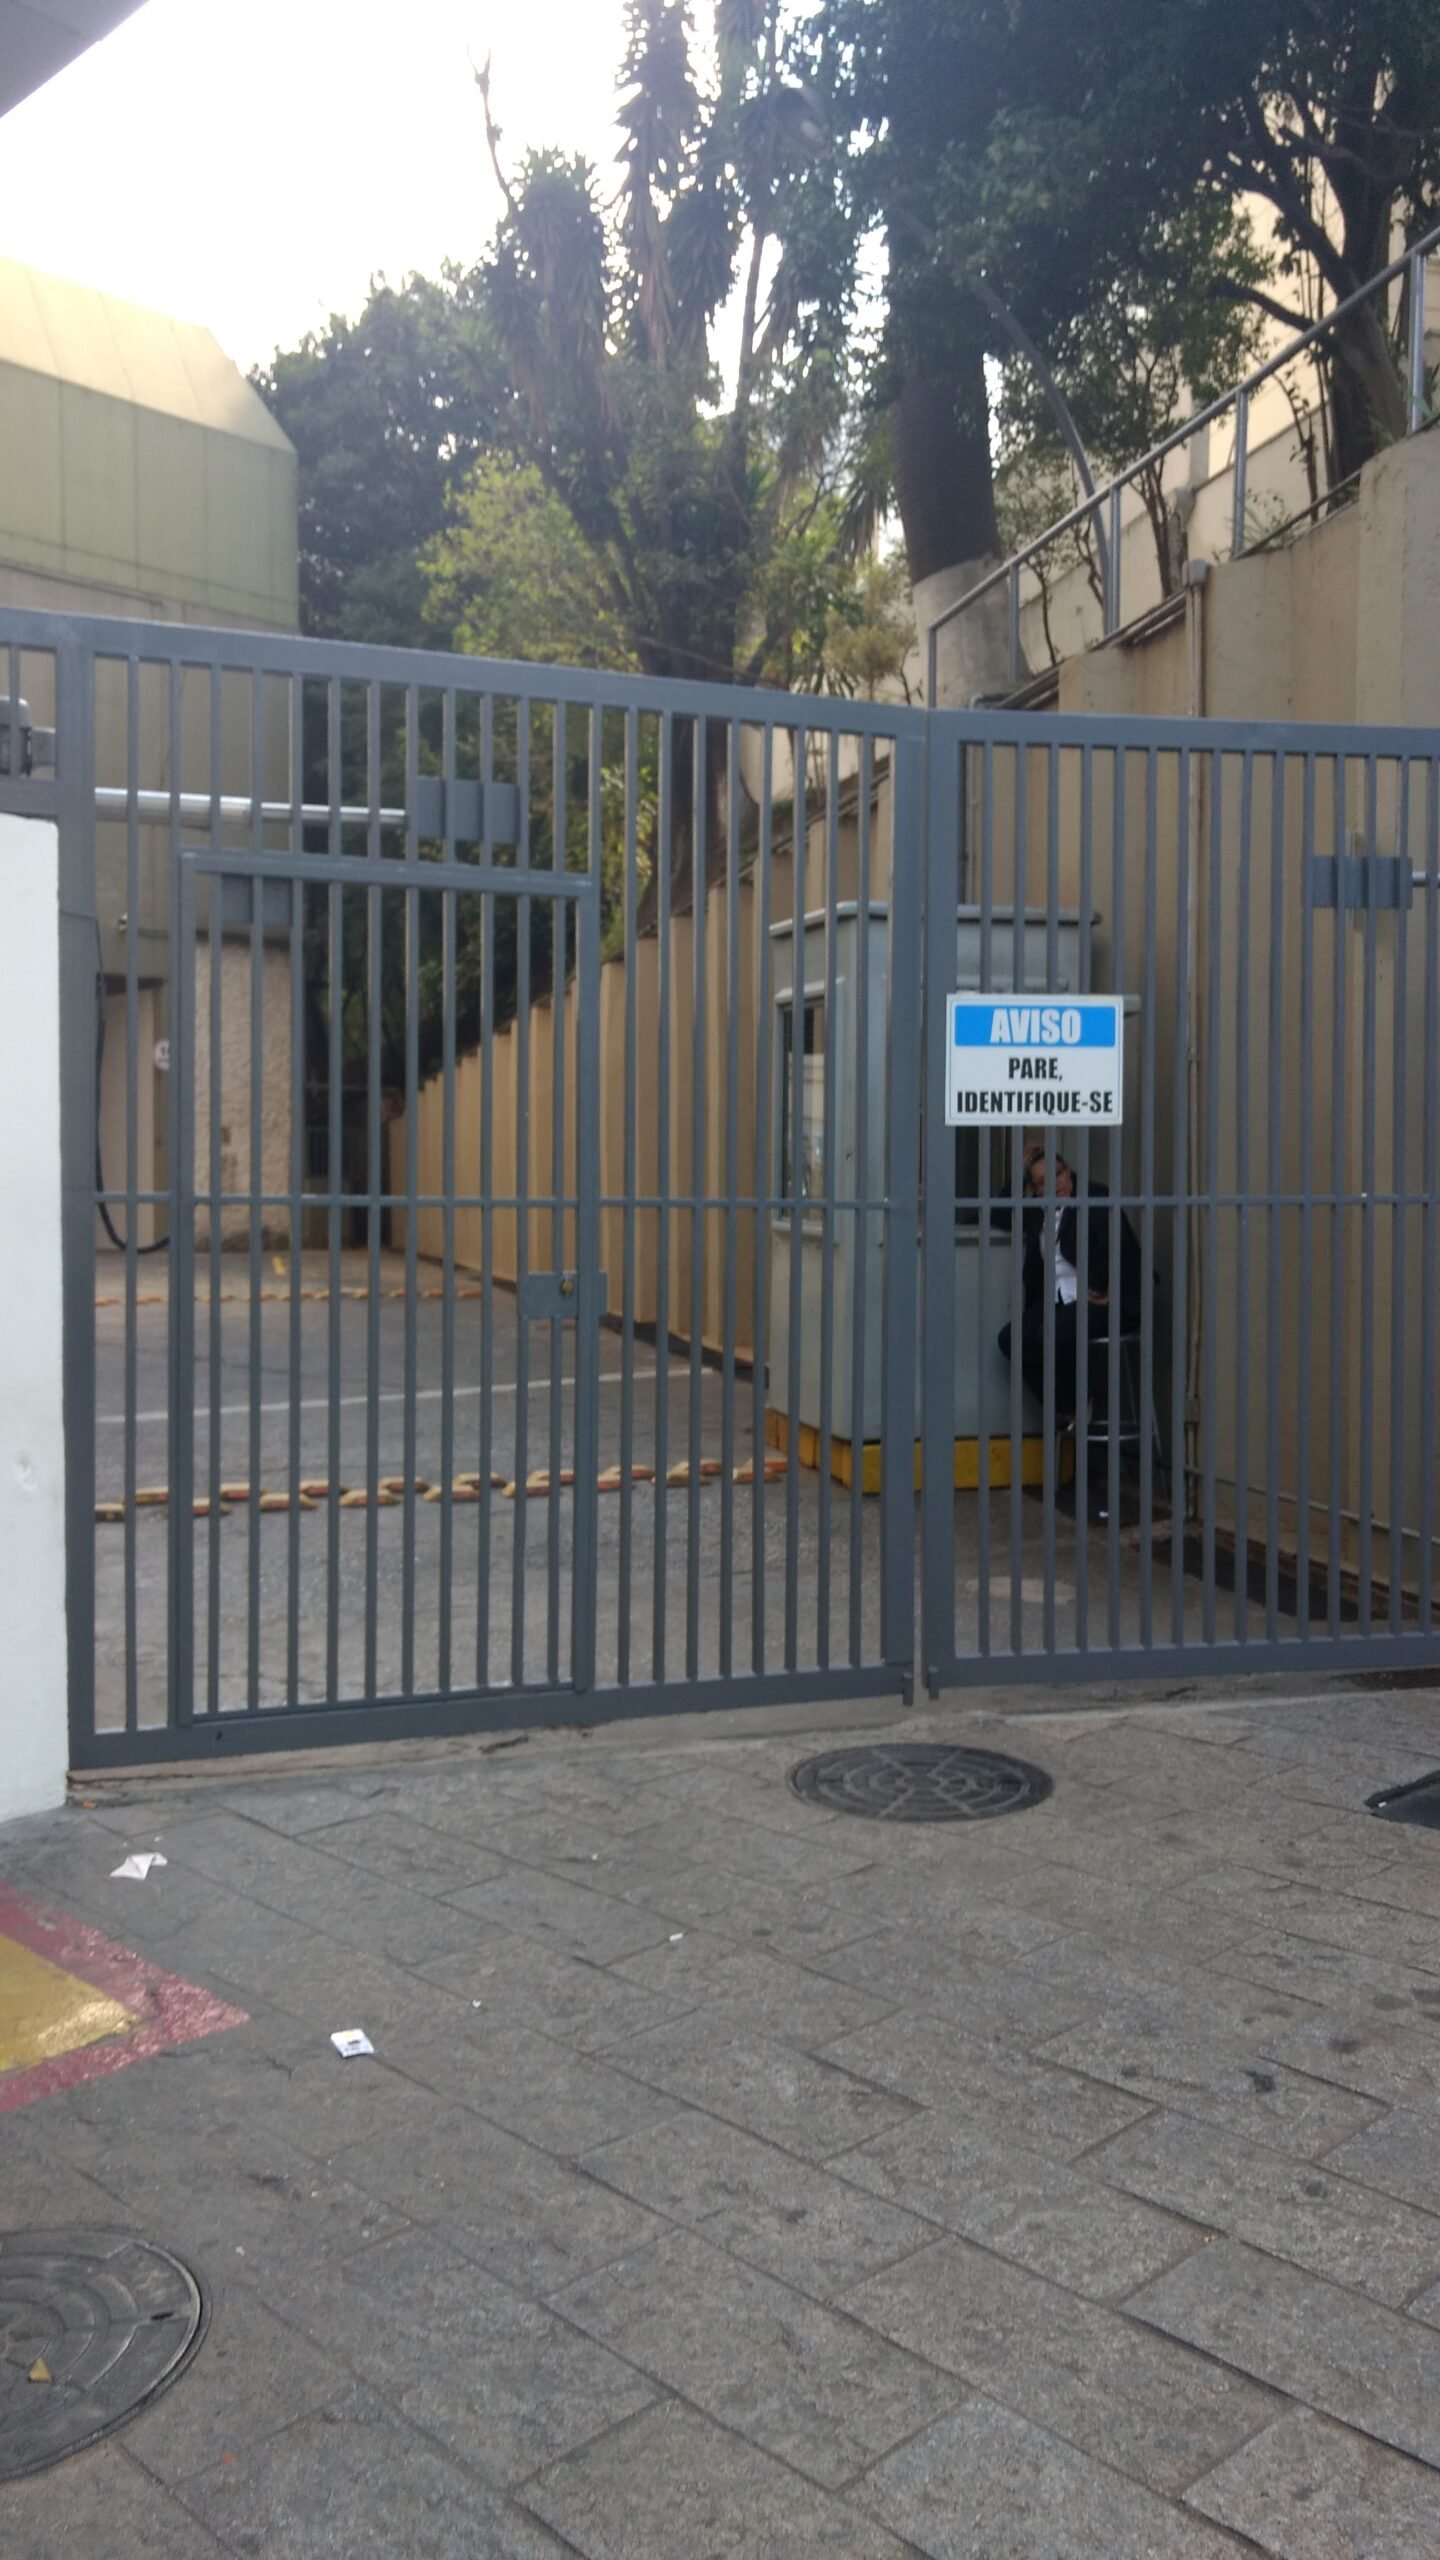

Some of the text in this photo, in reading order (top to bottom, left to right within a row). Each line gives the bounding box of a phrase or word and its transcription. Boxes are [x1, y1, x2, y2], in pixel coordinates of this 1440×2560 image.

[990, 1008, 1081, 1044] AVISO
[1008, 1057, 1063, 1081] PARE,
[957, 1091, 1113, 1115] IDENTIFIQUE-SE
